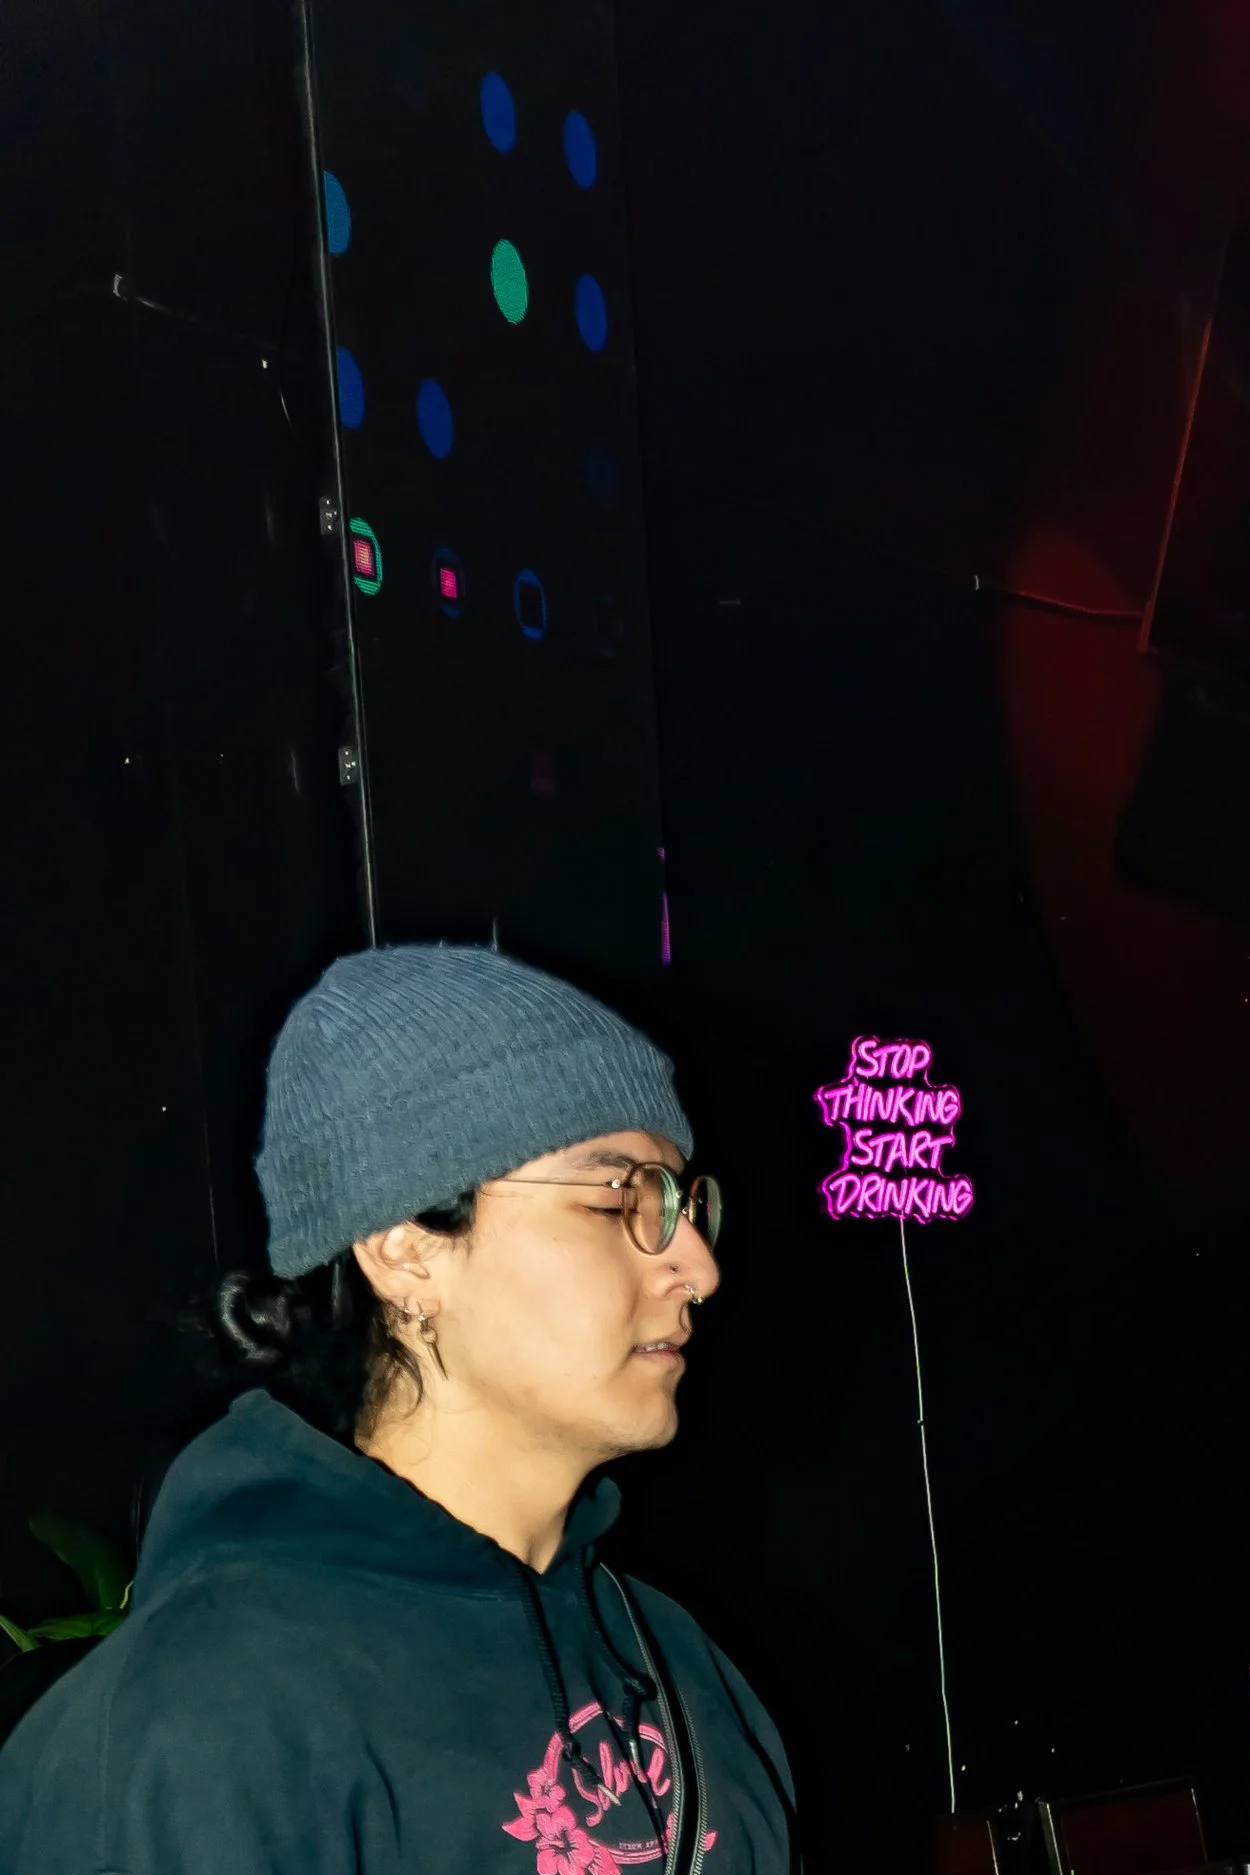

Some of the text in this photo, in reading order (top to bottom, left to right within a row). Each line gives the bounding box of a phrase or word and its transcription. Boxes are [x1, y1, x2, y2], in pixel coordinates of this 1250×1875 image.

[855, 1040, 931, 1079] STOP
[823, 1083, 960, 1127] THINKING
[851, 1129, 953, 1173] START
[829, 1172, 974, 1218] DRINKING
